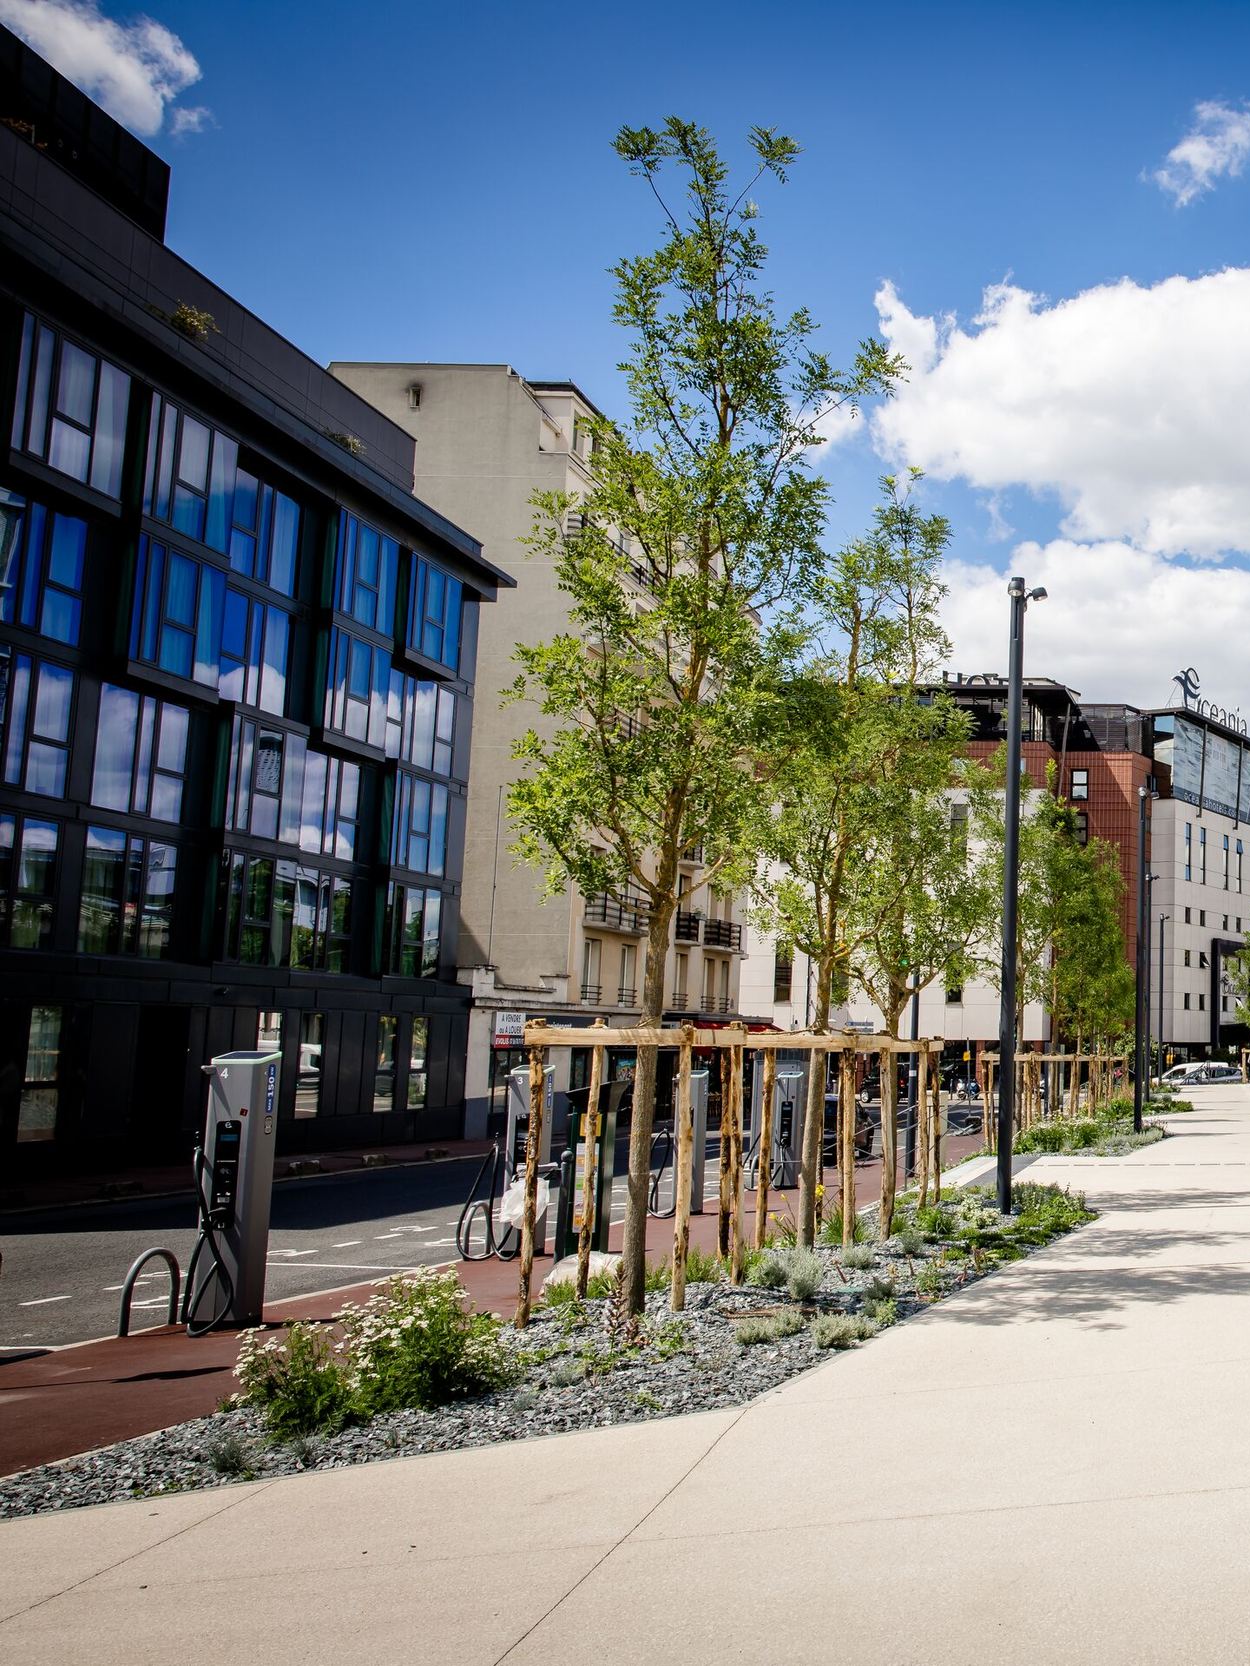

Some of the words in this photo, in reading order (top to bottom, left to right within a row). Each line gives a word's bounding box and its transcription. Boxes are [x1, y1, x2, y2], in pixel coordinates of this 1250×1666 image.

[505, 1014, 522, 1023] VENDRE
[508, 1026, 522, 1034] LOUER
[220, 1067, 229, 1079] 4
[518, 1076, 523, 1085] 3
[267, 1076, 275, 1097] 150
